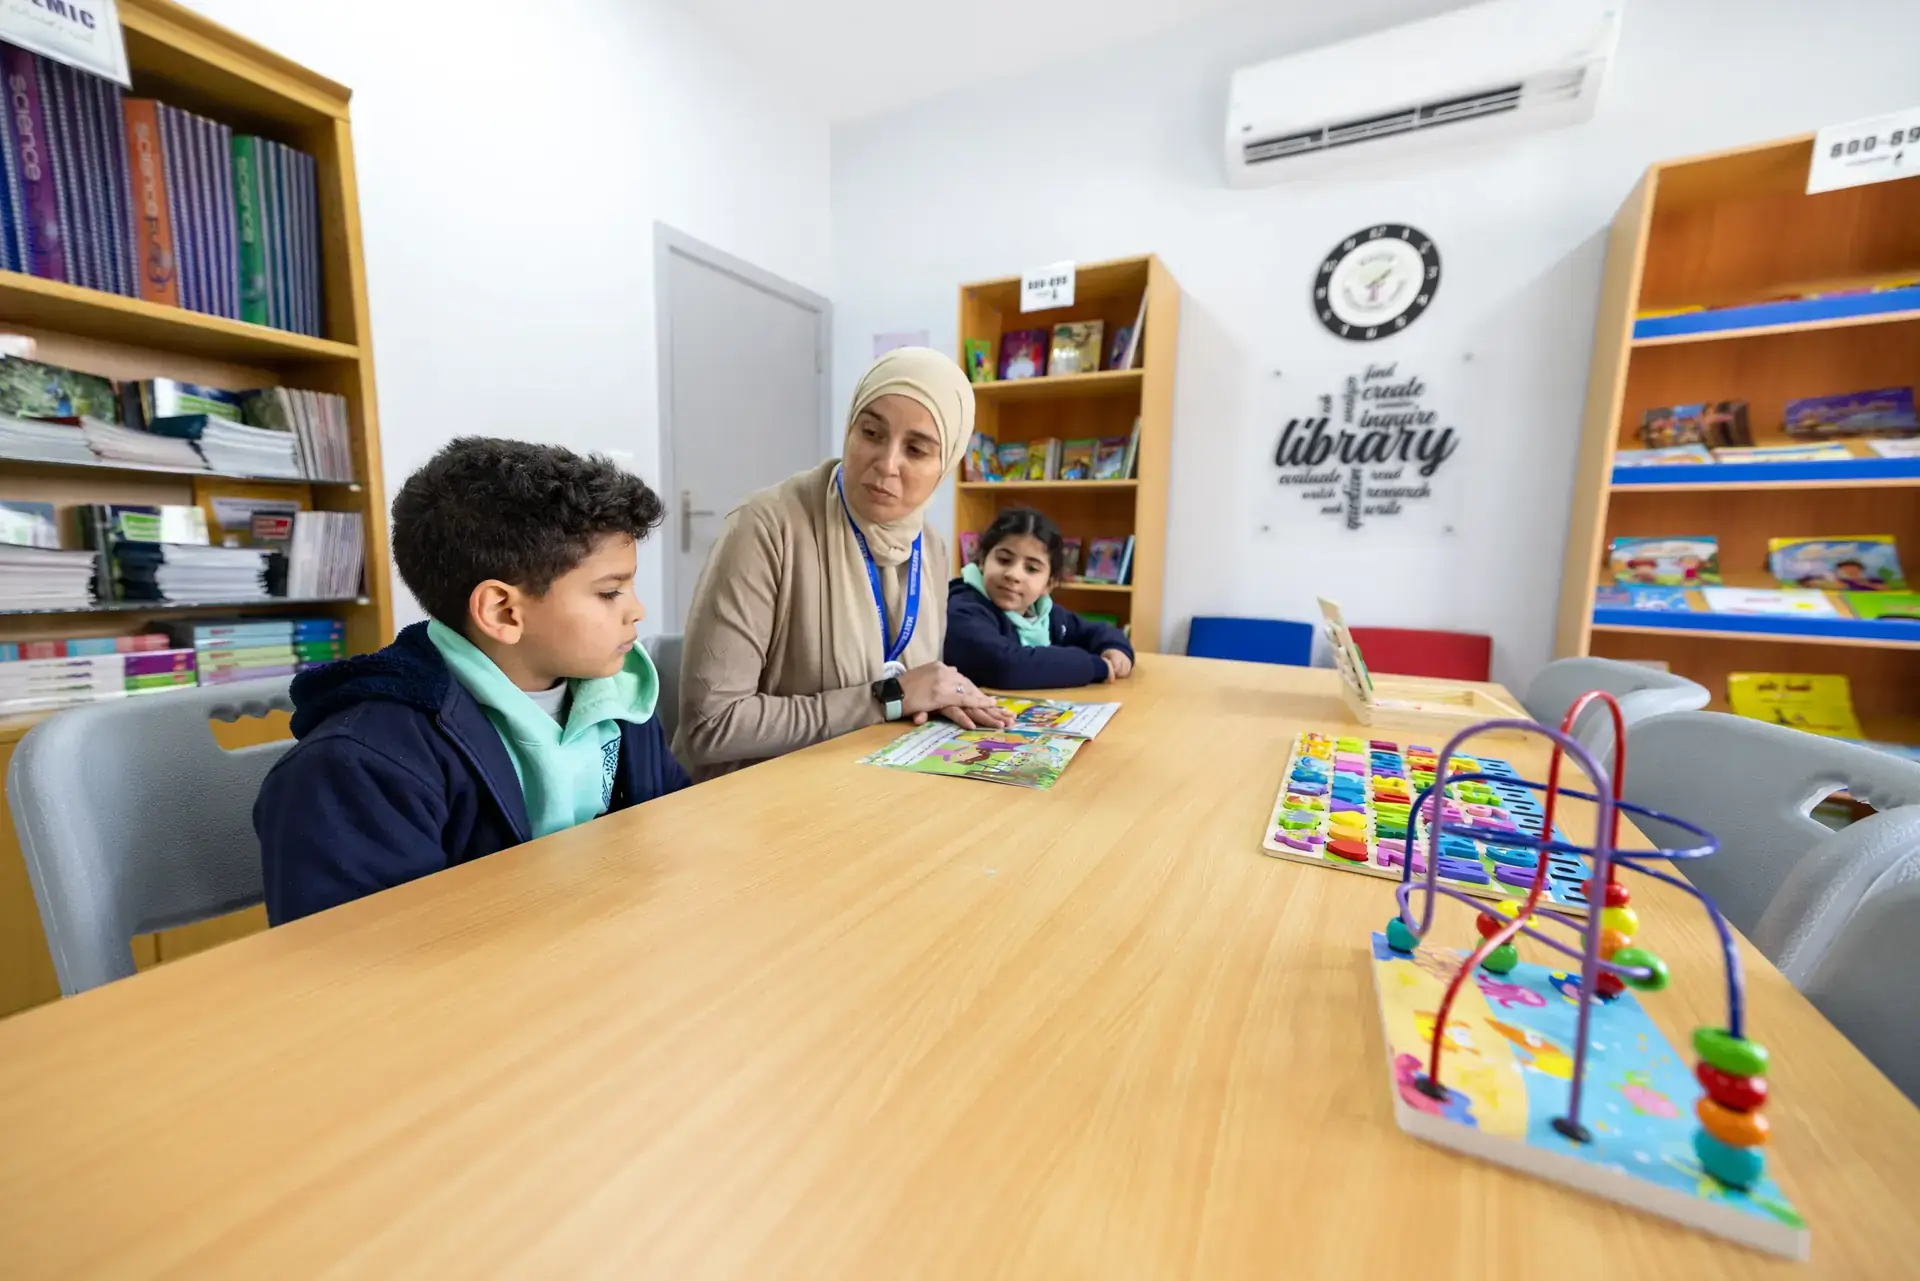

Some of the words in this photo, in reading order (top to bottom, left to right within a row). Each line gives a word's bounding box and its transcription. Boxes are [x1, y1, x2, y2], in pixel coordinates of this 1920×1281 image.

[9, 74, 41, 181] science
[1362, 376, 1426, 400] create
[1275, 417, 1460, 477] library
